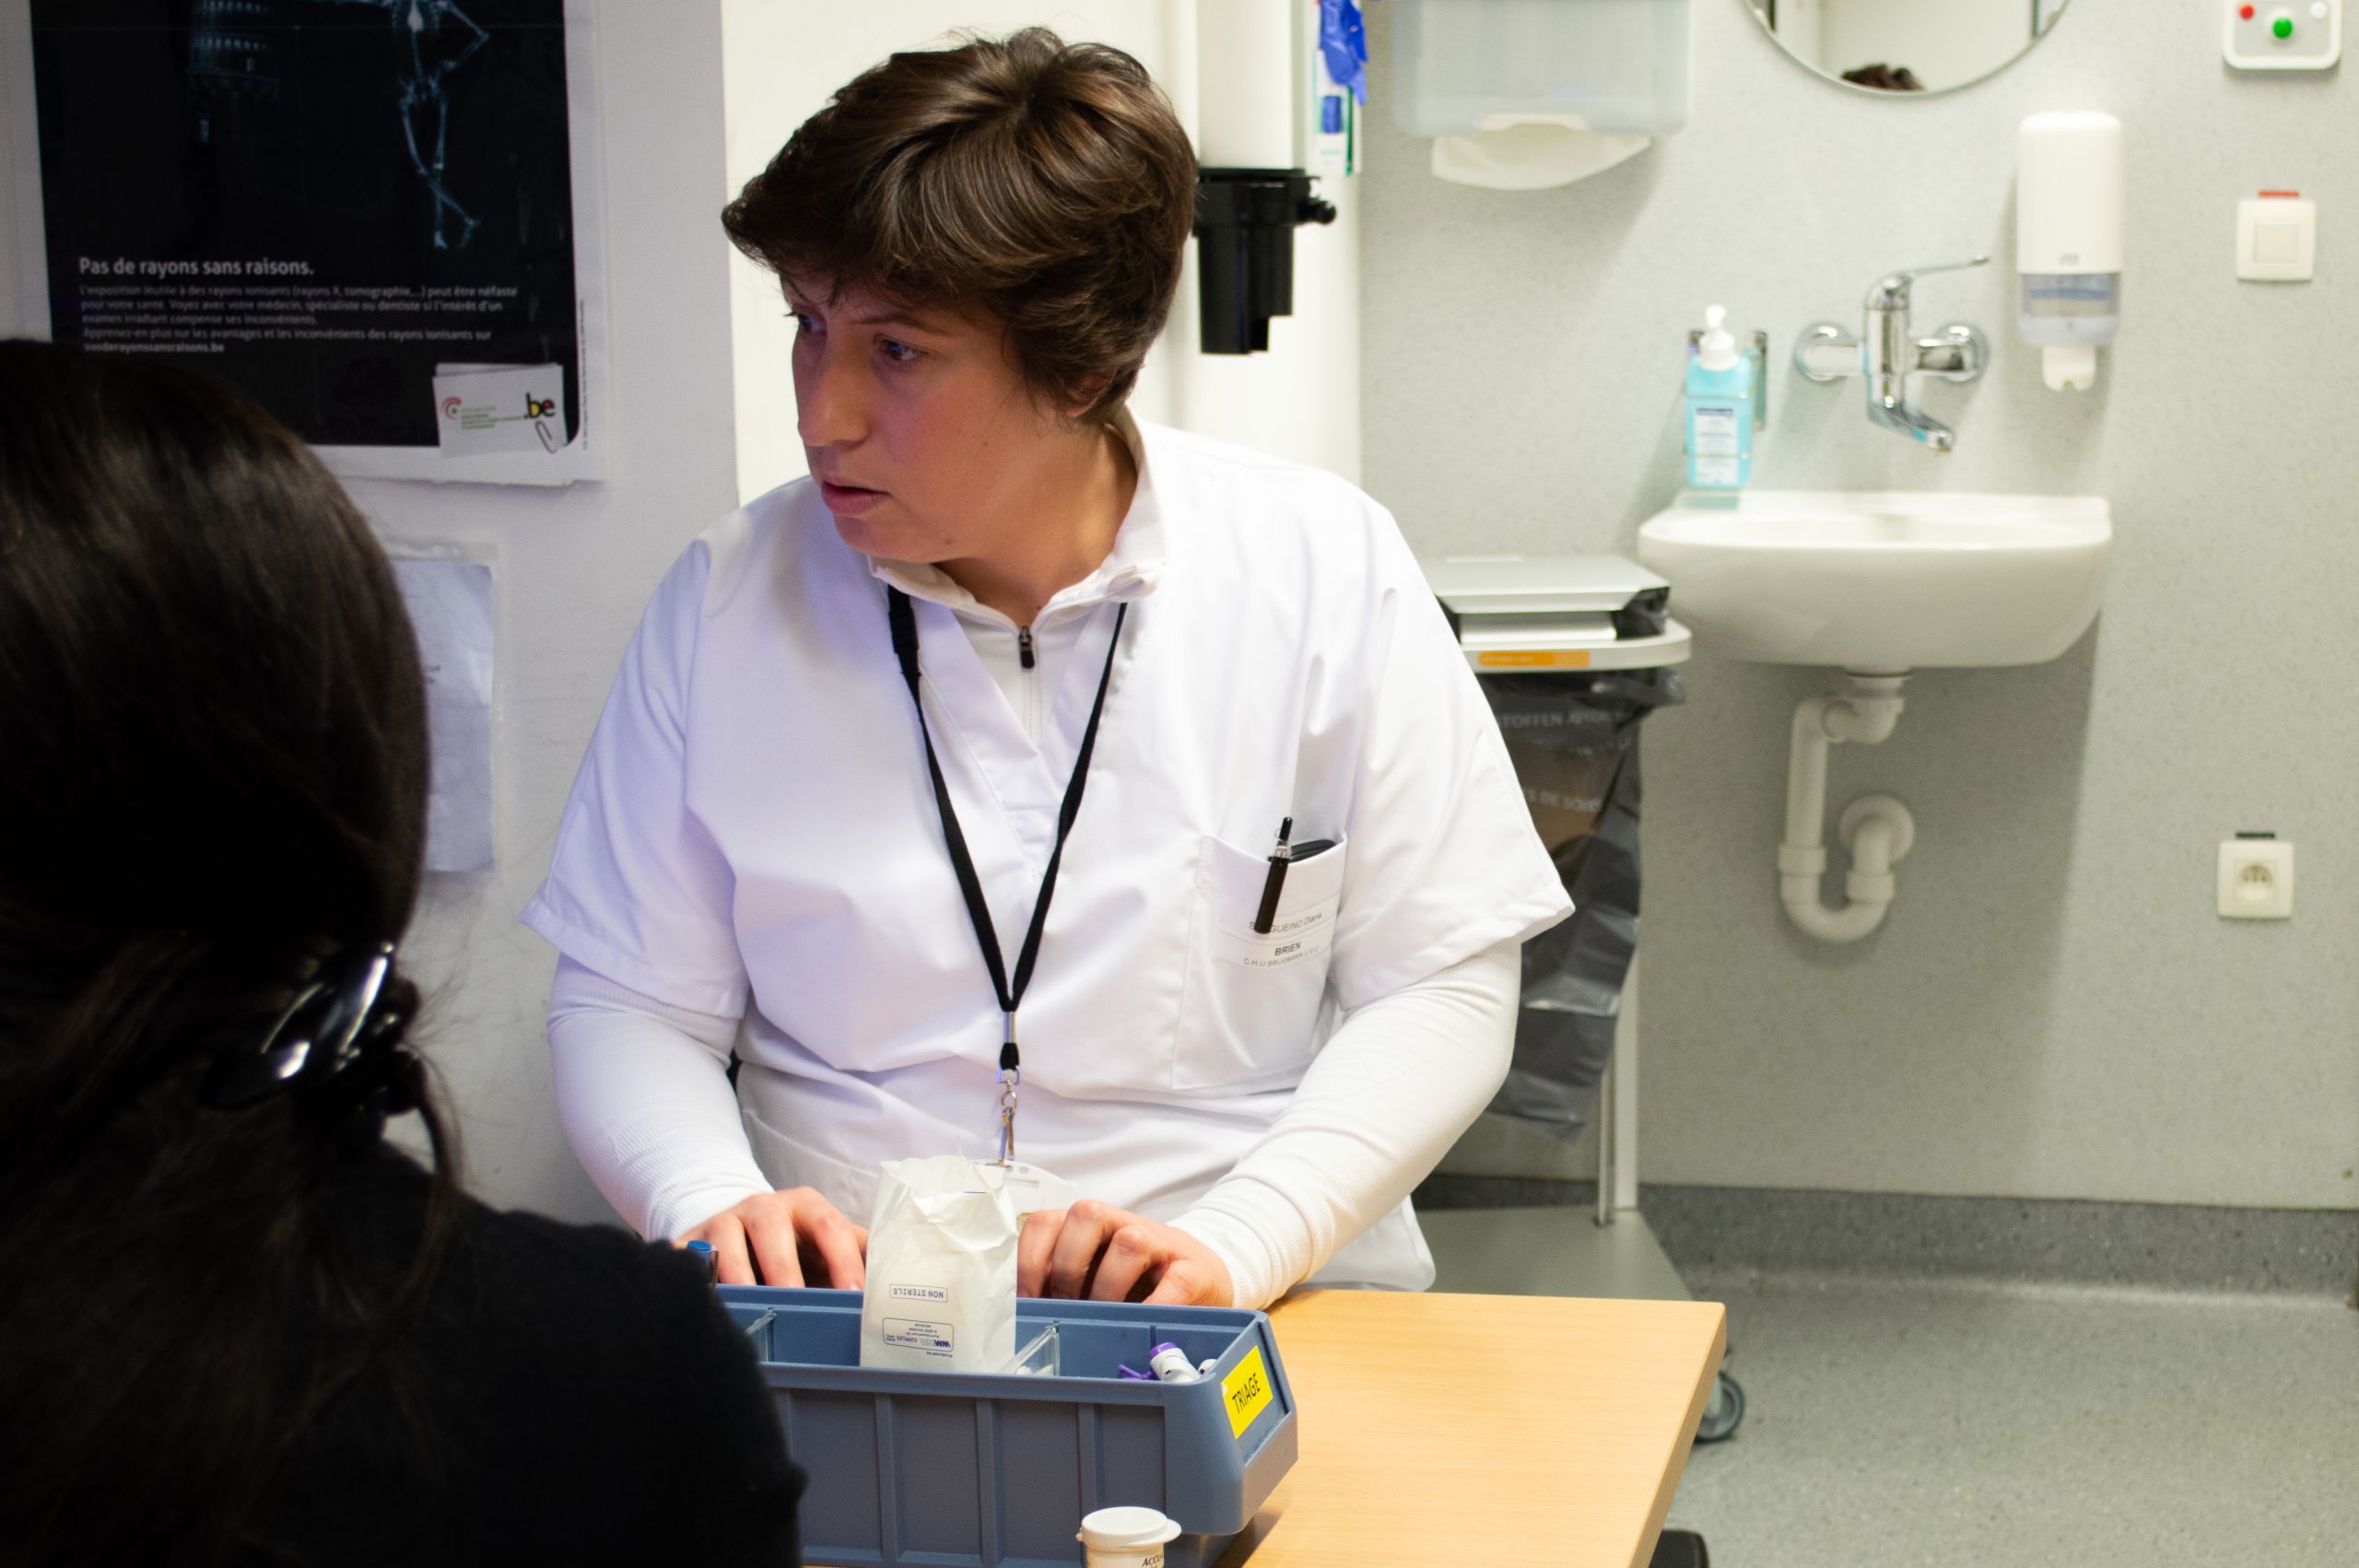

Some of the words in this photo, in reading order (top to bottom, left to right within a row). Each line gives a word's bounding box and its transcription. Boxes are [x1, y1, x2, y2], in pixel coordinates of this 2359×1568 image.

[79, 256, 109, 275] Pas
[113, 256, 135, 275] de
[140, 261, 198, 279] rayons
[203, 261, 241, 275] sans
[246, 256, 314, 275] raisons.
[144, 286, 176, 296] inutile
[188, 285, 205, 295] des
[207, 287, 242, 298] rayons
[244, 286, 290, 296] ionisants
[292, 285, 330, 298] (rayons
[428, 287, 452, 298] peut
[453, 285, 475, 297] être
[477, 285, 518, 298] néfaste
[81, 301, 104, 311] pour
[107, 301, 134, 310] votre
[169, 299, 200, 311] Voyez
[202, 301, 225, 310] avec
[228, 301, 254, 310] votre
[305, 299, 359, 313] spécialiste
[361, 302, 376, 311] ou
[377, 300, 420, 311] dentiste
[423, 300, 432, 311] si
[478, 299, 503, 311] d'un
[82, 315, 123, 324] examen
[170, 315, 222, 326] compense
[225, 315, 241, 324] ses
[149, 328, 172, 340] plus
[209, 330, 262, 341] avantages
[264, 329, 275, 339] et
[276, 328, 291, 339] les
[293, 329, 366, 340] inconvénients
[368, 328, 386, 340] des
[388, 330, 423, 343] rayons
[425, 329, 473, 341] ionisants
[475, 331, 492, 340] sur
[1274, 942, 1302, 956] BRIEN
[893, 1288, 926, 1297] STERILE
[928, 1290, 945, 1299] NON
[1232, 1372, 1261, 1414] TRIAGE
